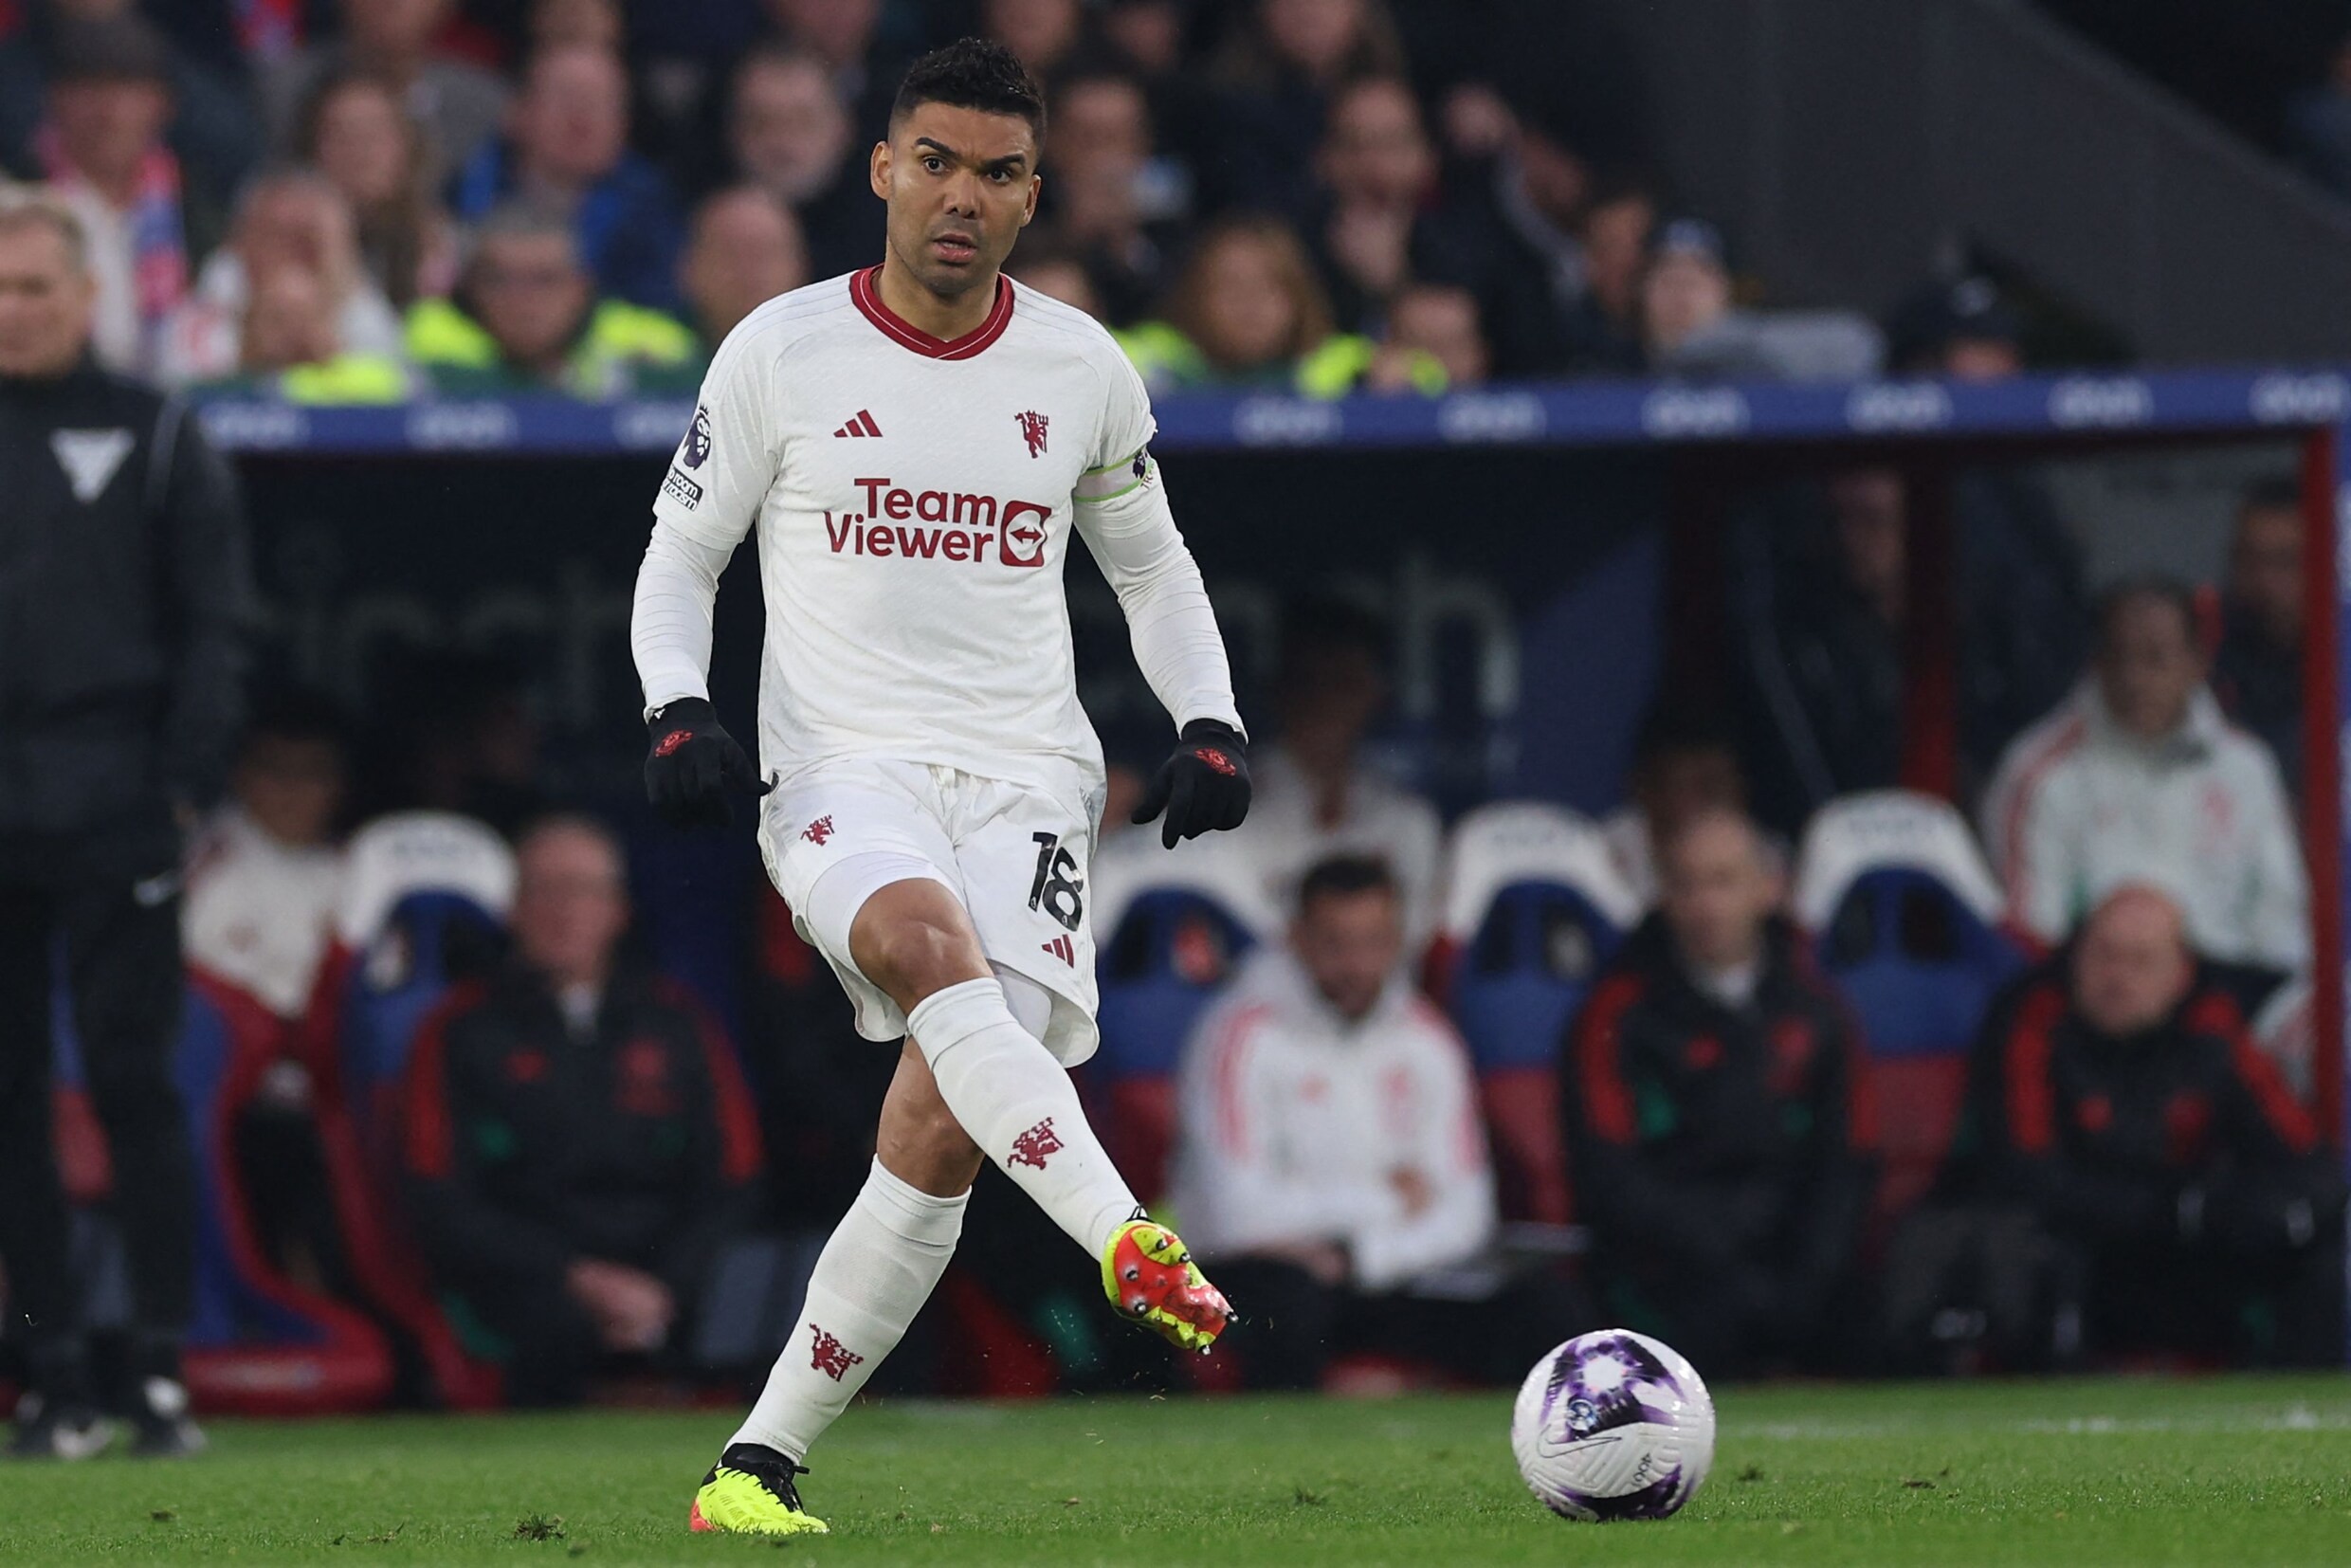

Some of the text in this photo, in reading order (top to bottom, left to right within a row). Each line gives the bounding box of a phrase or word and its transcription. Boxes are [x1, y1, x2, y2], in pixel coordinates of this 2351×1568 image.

[672, 472, 699, 499] room
[854, 478, 997, 527] Team
[823, 510, 994, 563] Viewer
[1029, 831, 1084, 932] 18
